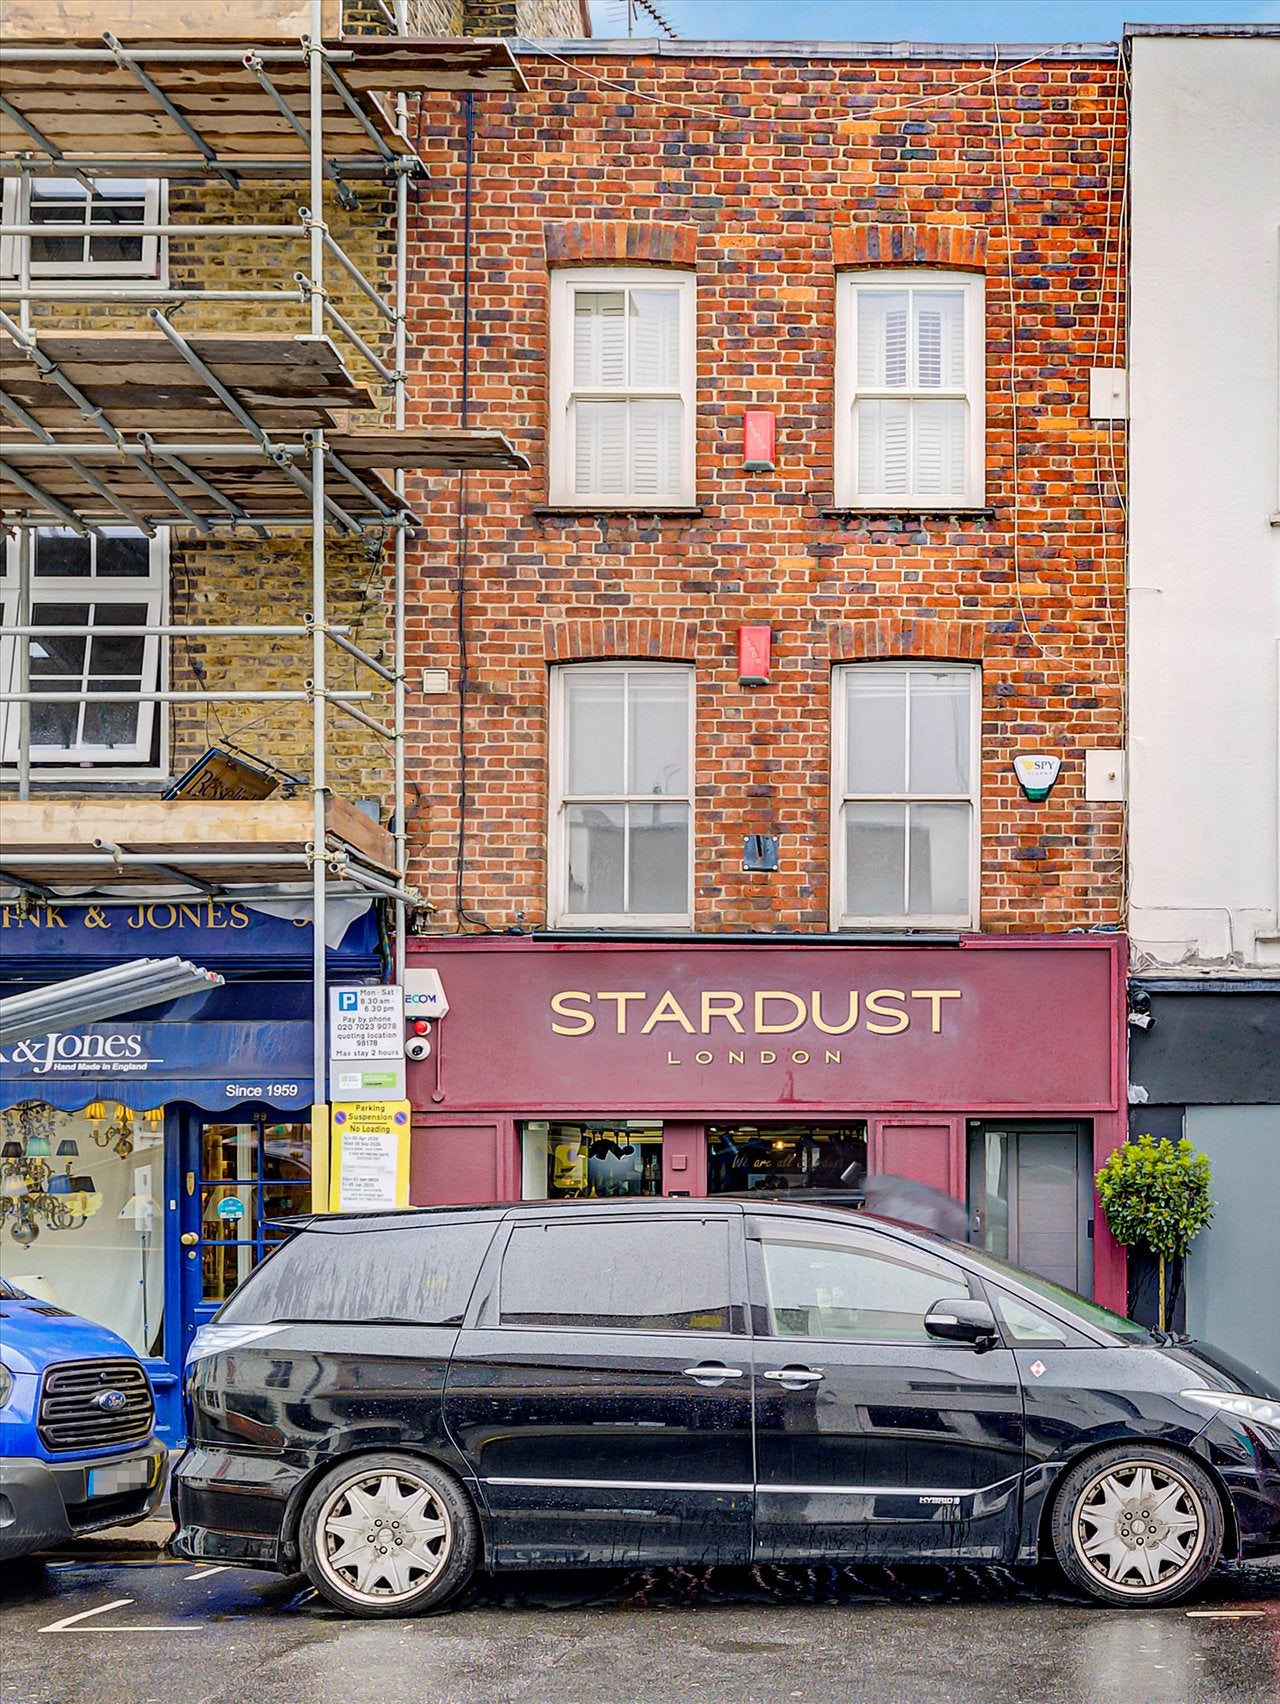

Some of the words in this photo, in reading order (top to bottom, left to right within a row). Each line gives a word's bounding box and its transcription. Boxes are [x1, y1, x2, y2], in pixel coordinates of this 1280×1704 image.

[1034, 760, 1054, 770] SPY
[84, 904, 112, 929] &
[127, 902, 250, 929] JONES
[381, 988, 394, 996] Sat
[343, 993, 356, 1010] P
[550, 989, 962, 1036] STARDUST
[356, 1039, 378, 1047] 98178
[667, 1050, 843, 1066] LONDON
[53, 1063, 76, 1071] Hand
[77, 1063, 101, 1071] Made
[112, 1063, 148, 1072] England
[225, 1084, 262, 1096] Since
[266, 1084, 298, 1096] 1959
[356, 1104, 385, 1112] Parking
[253, 1112, 267, 1121] 99
[348, 1113, 393, 1121] Suspension
[350, 1125, 360, 1133] No
[362, 1125, 391, 1134] Loading
[754, 1158, 772, 1168] are
[919, 1496, 953, 1504] HYBRID
